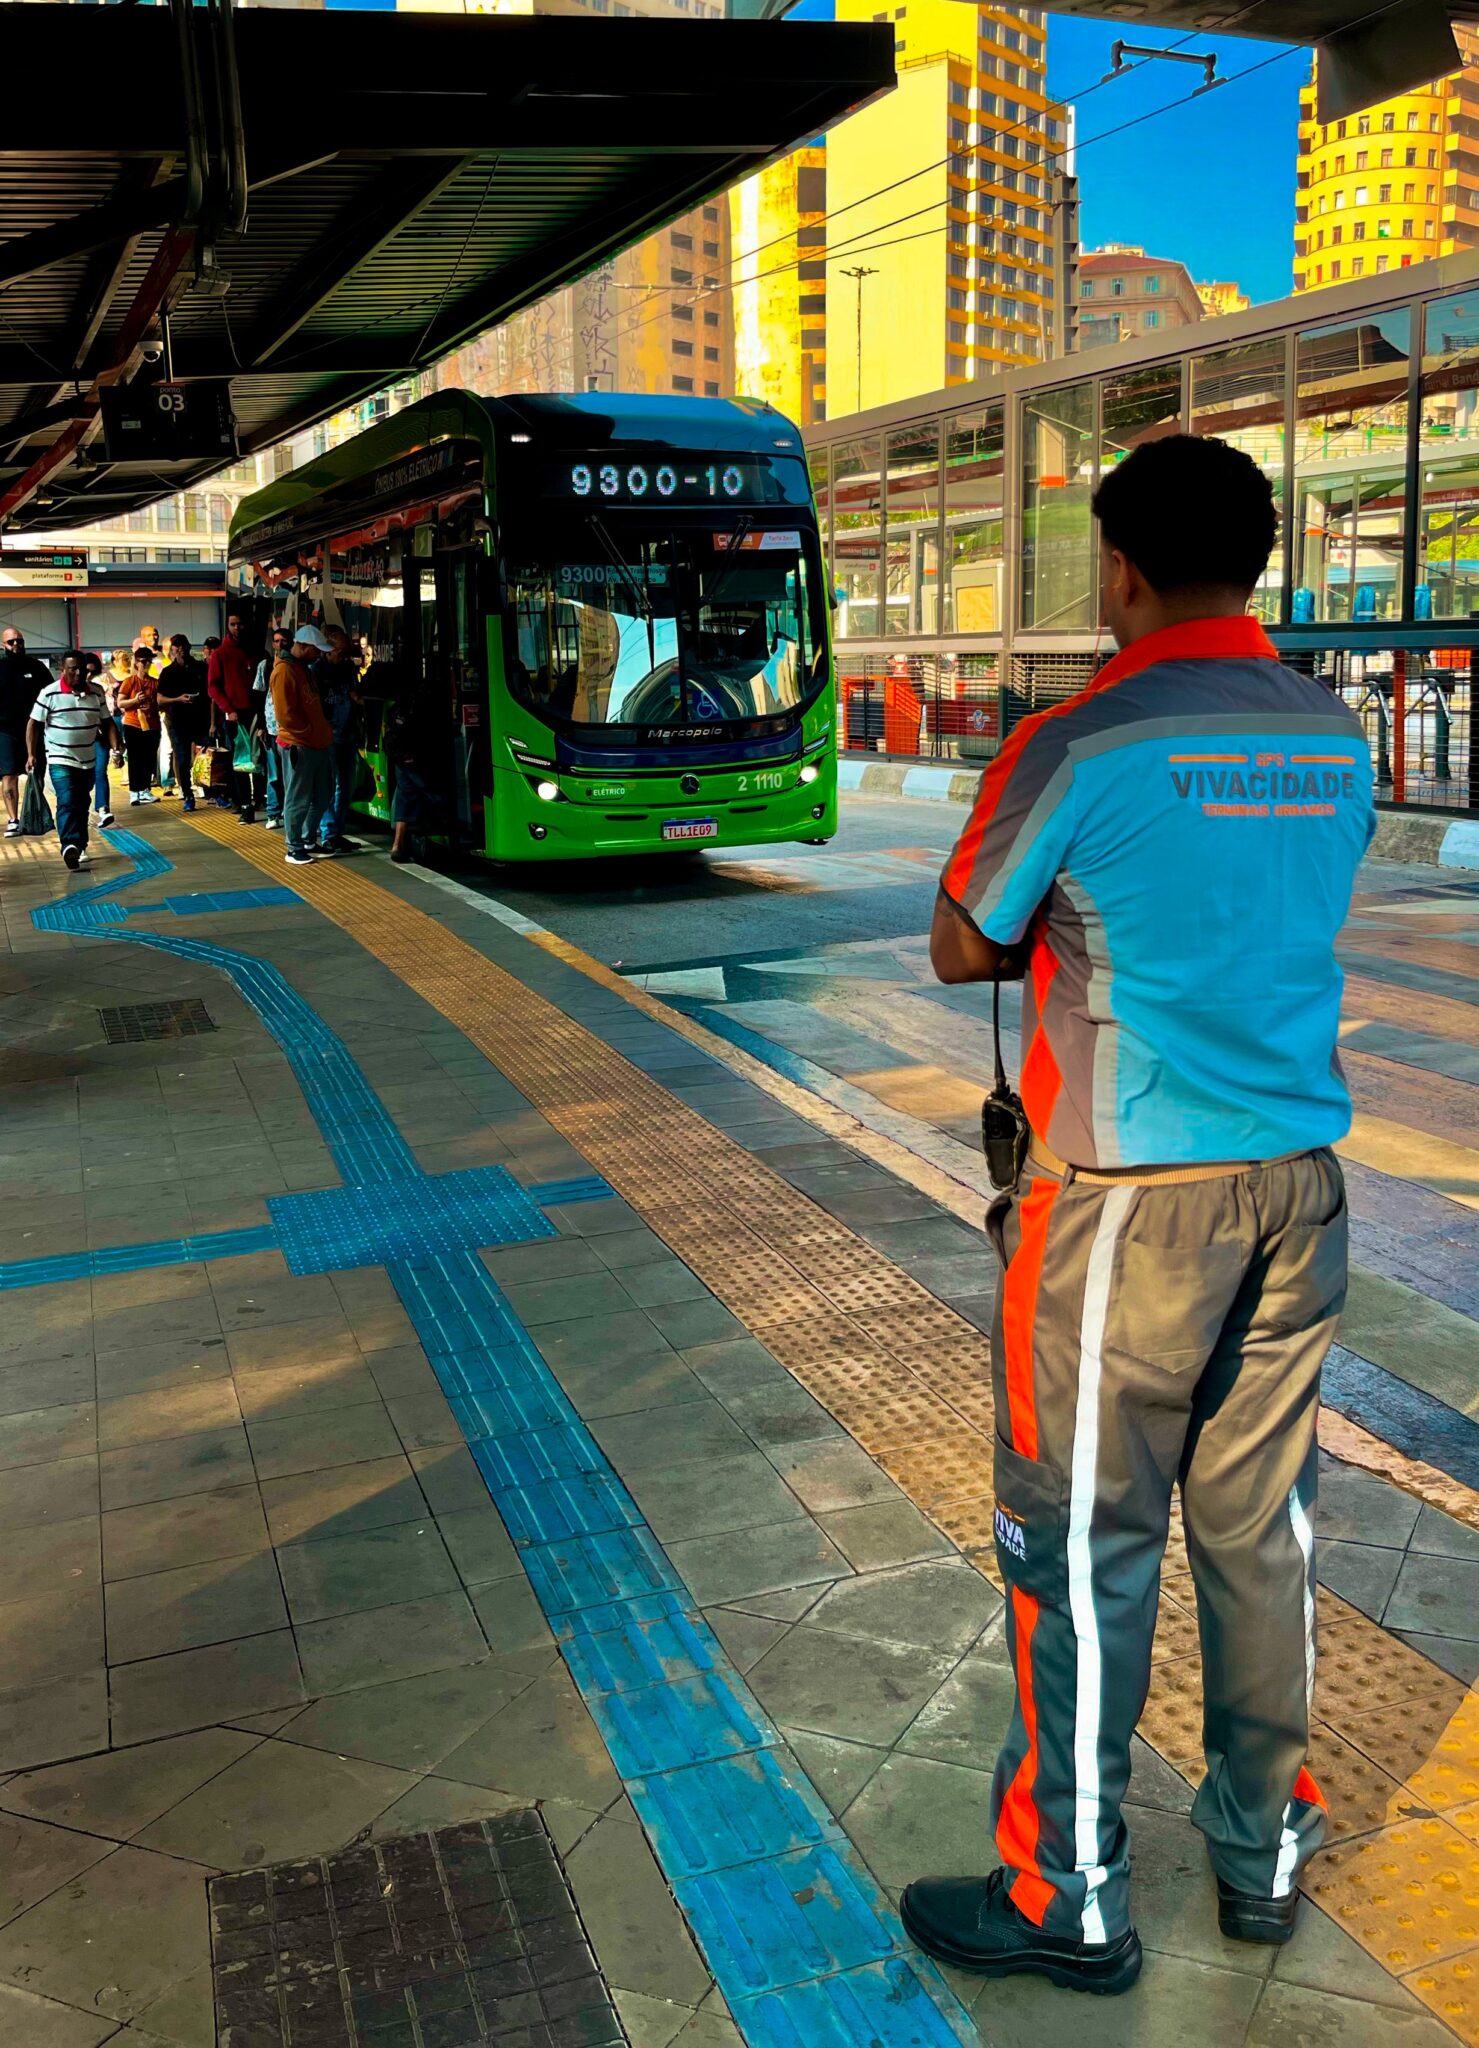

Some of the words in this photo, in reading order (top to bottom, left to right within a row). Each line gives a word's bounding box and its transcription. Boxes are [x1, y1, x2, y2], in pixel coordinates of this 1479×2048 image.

[158, 394, 185, 411] 03
[408, 454, 438, 484] ELÉTRICO
[572, 465, 743, 495] 9300-10
[561, 566, 605, 582] 9300
[373, 641, 394, 662] SAÚDE
[648, 727, 722, 739] Marcopolo
[738, 776, 748, 791] 2
[753, 773, 783, 790] 1110
[1170, 771, 1355, 800] VIVACIDADE
[593, 786, 626, 796] ELÉTRICO
[1202, 803, 1269, 817] TERMINAIS
[1274, 803, 1336, 817] URBANOS
